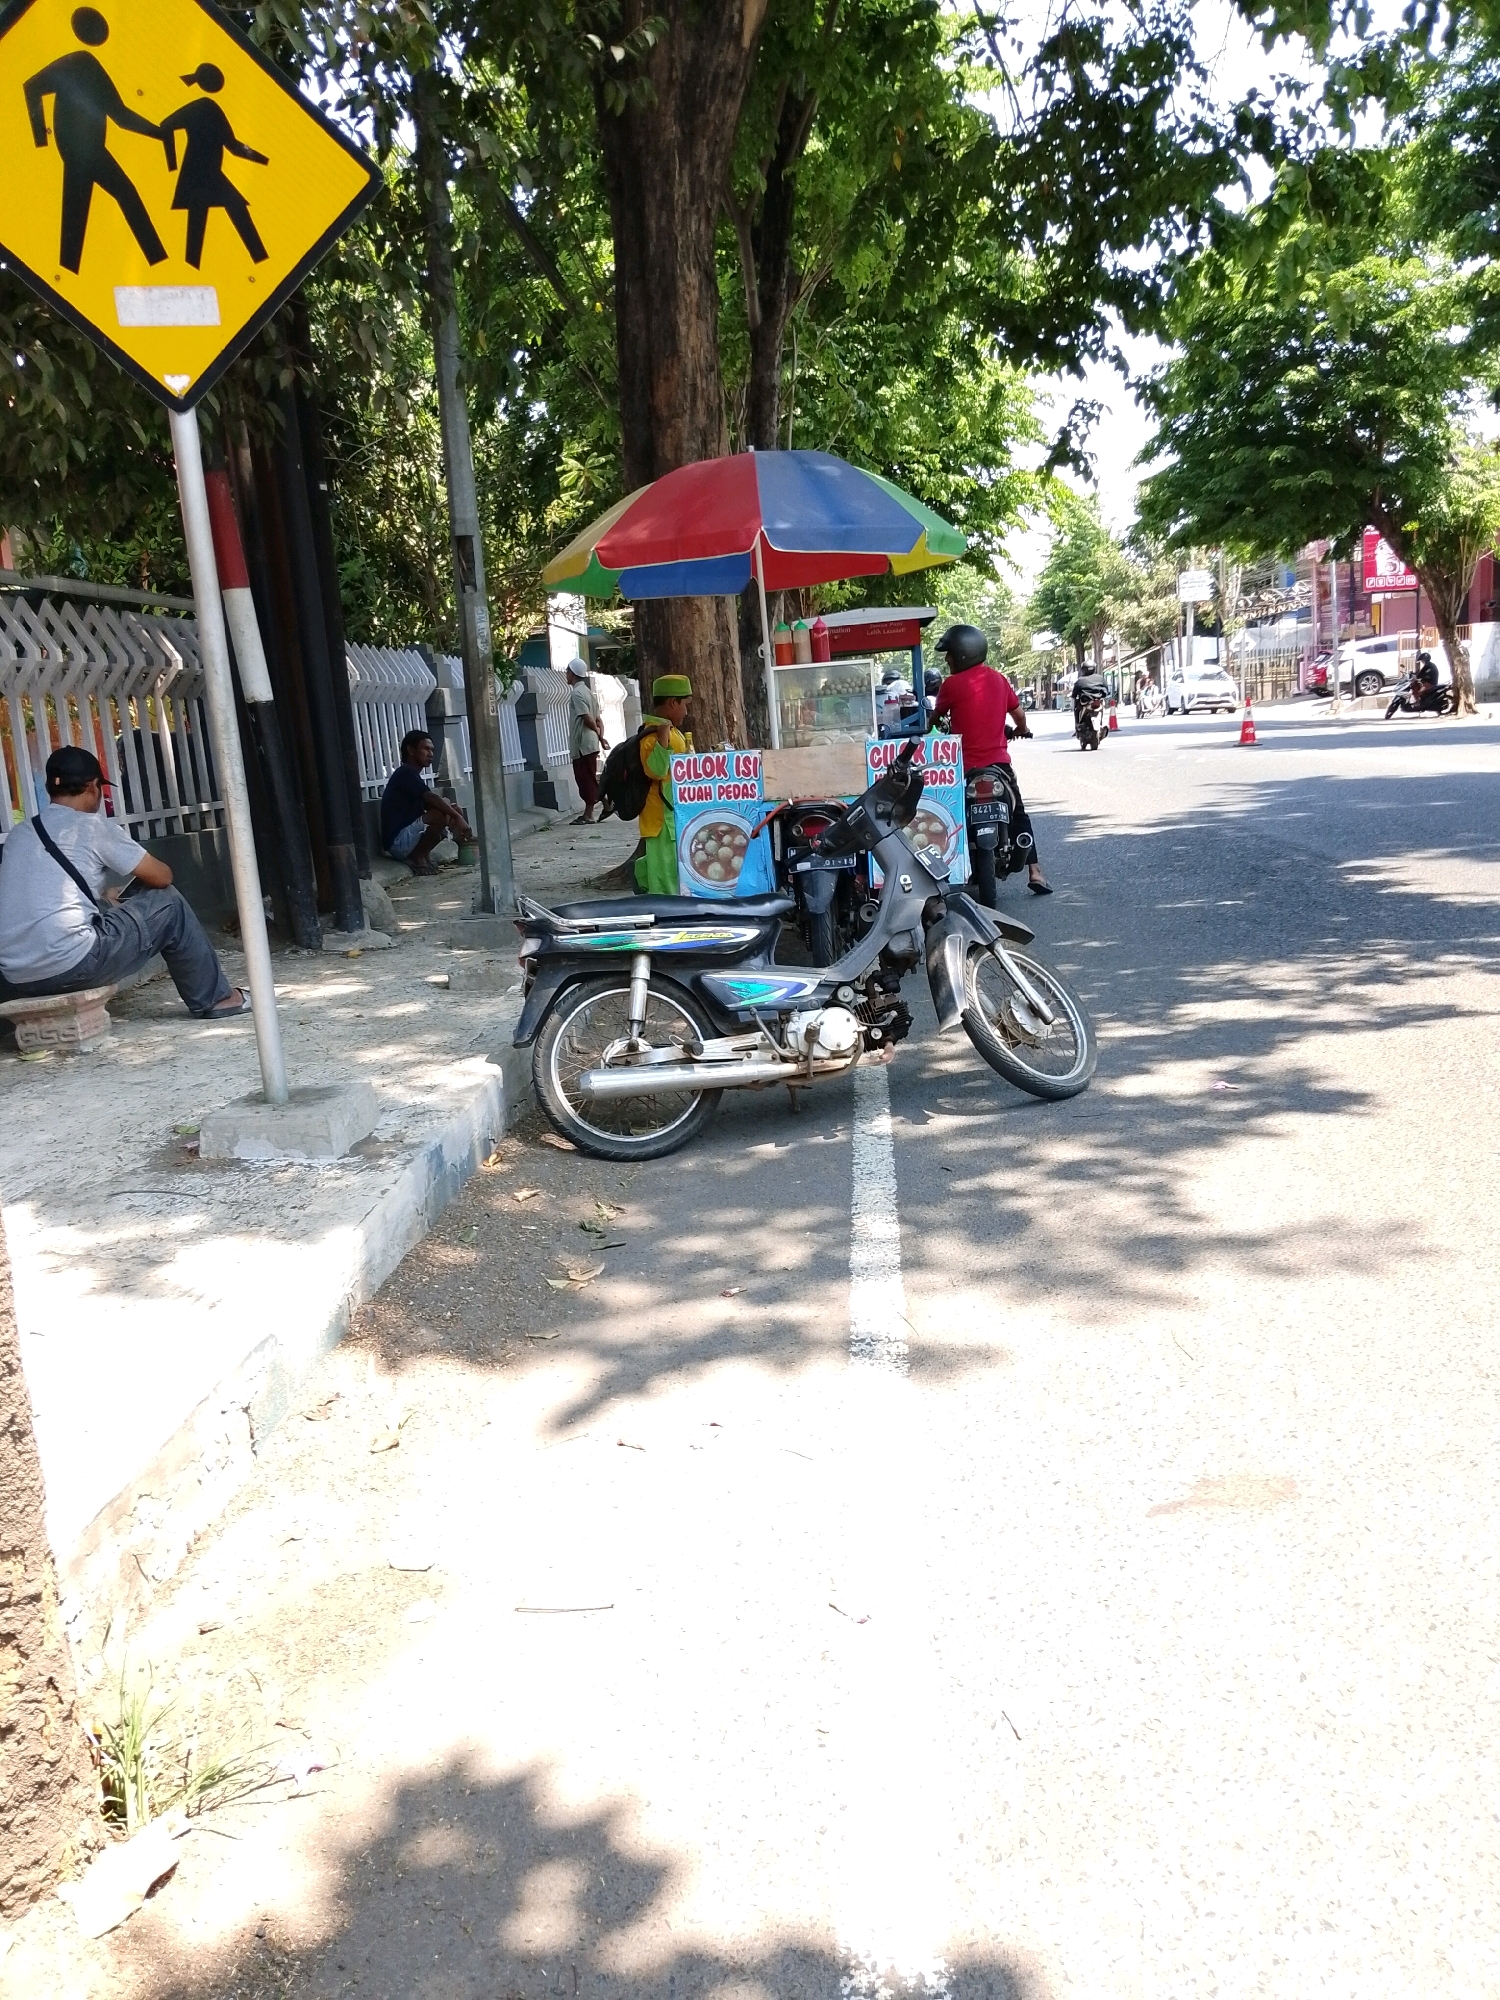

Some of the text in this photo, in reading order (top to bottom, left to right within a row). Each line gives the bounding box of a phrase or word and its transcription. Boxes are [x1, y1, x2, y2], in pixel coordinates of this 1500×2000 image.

[932, 740, 958, 765] ISI
[672, 754, 759, 783] CILOK ISI
[678, 783, 757, 803] KUAH PEDAS
